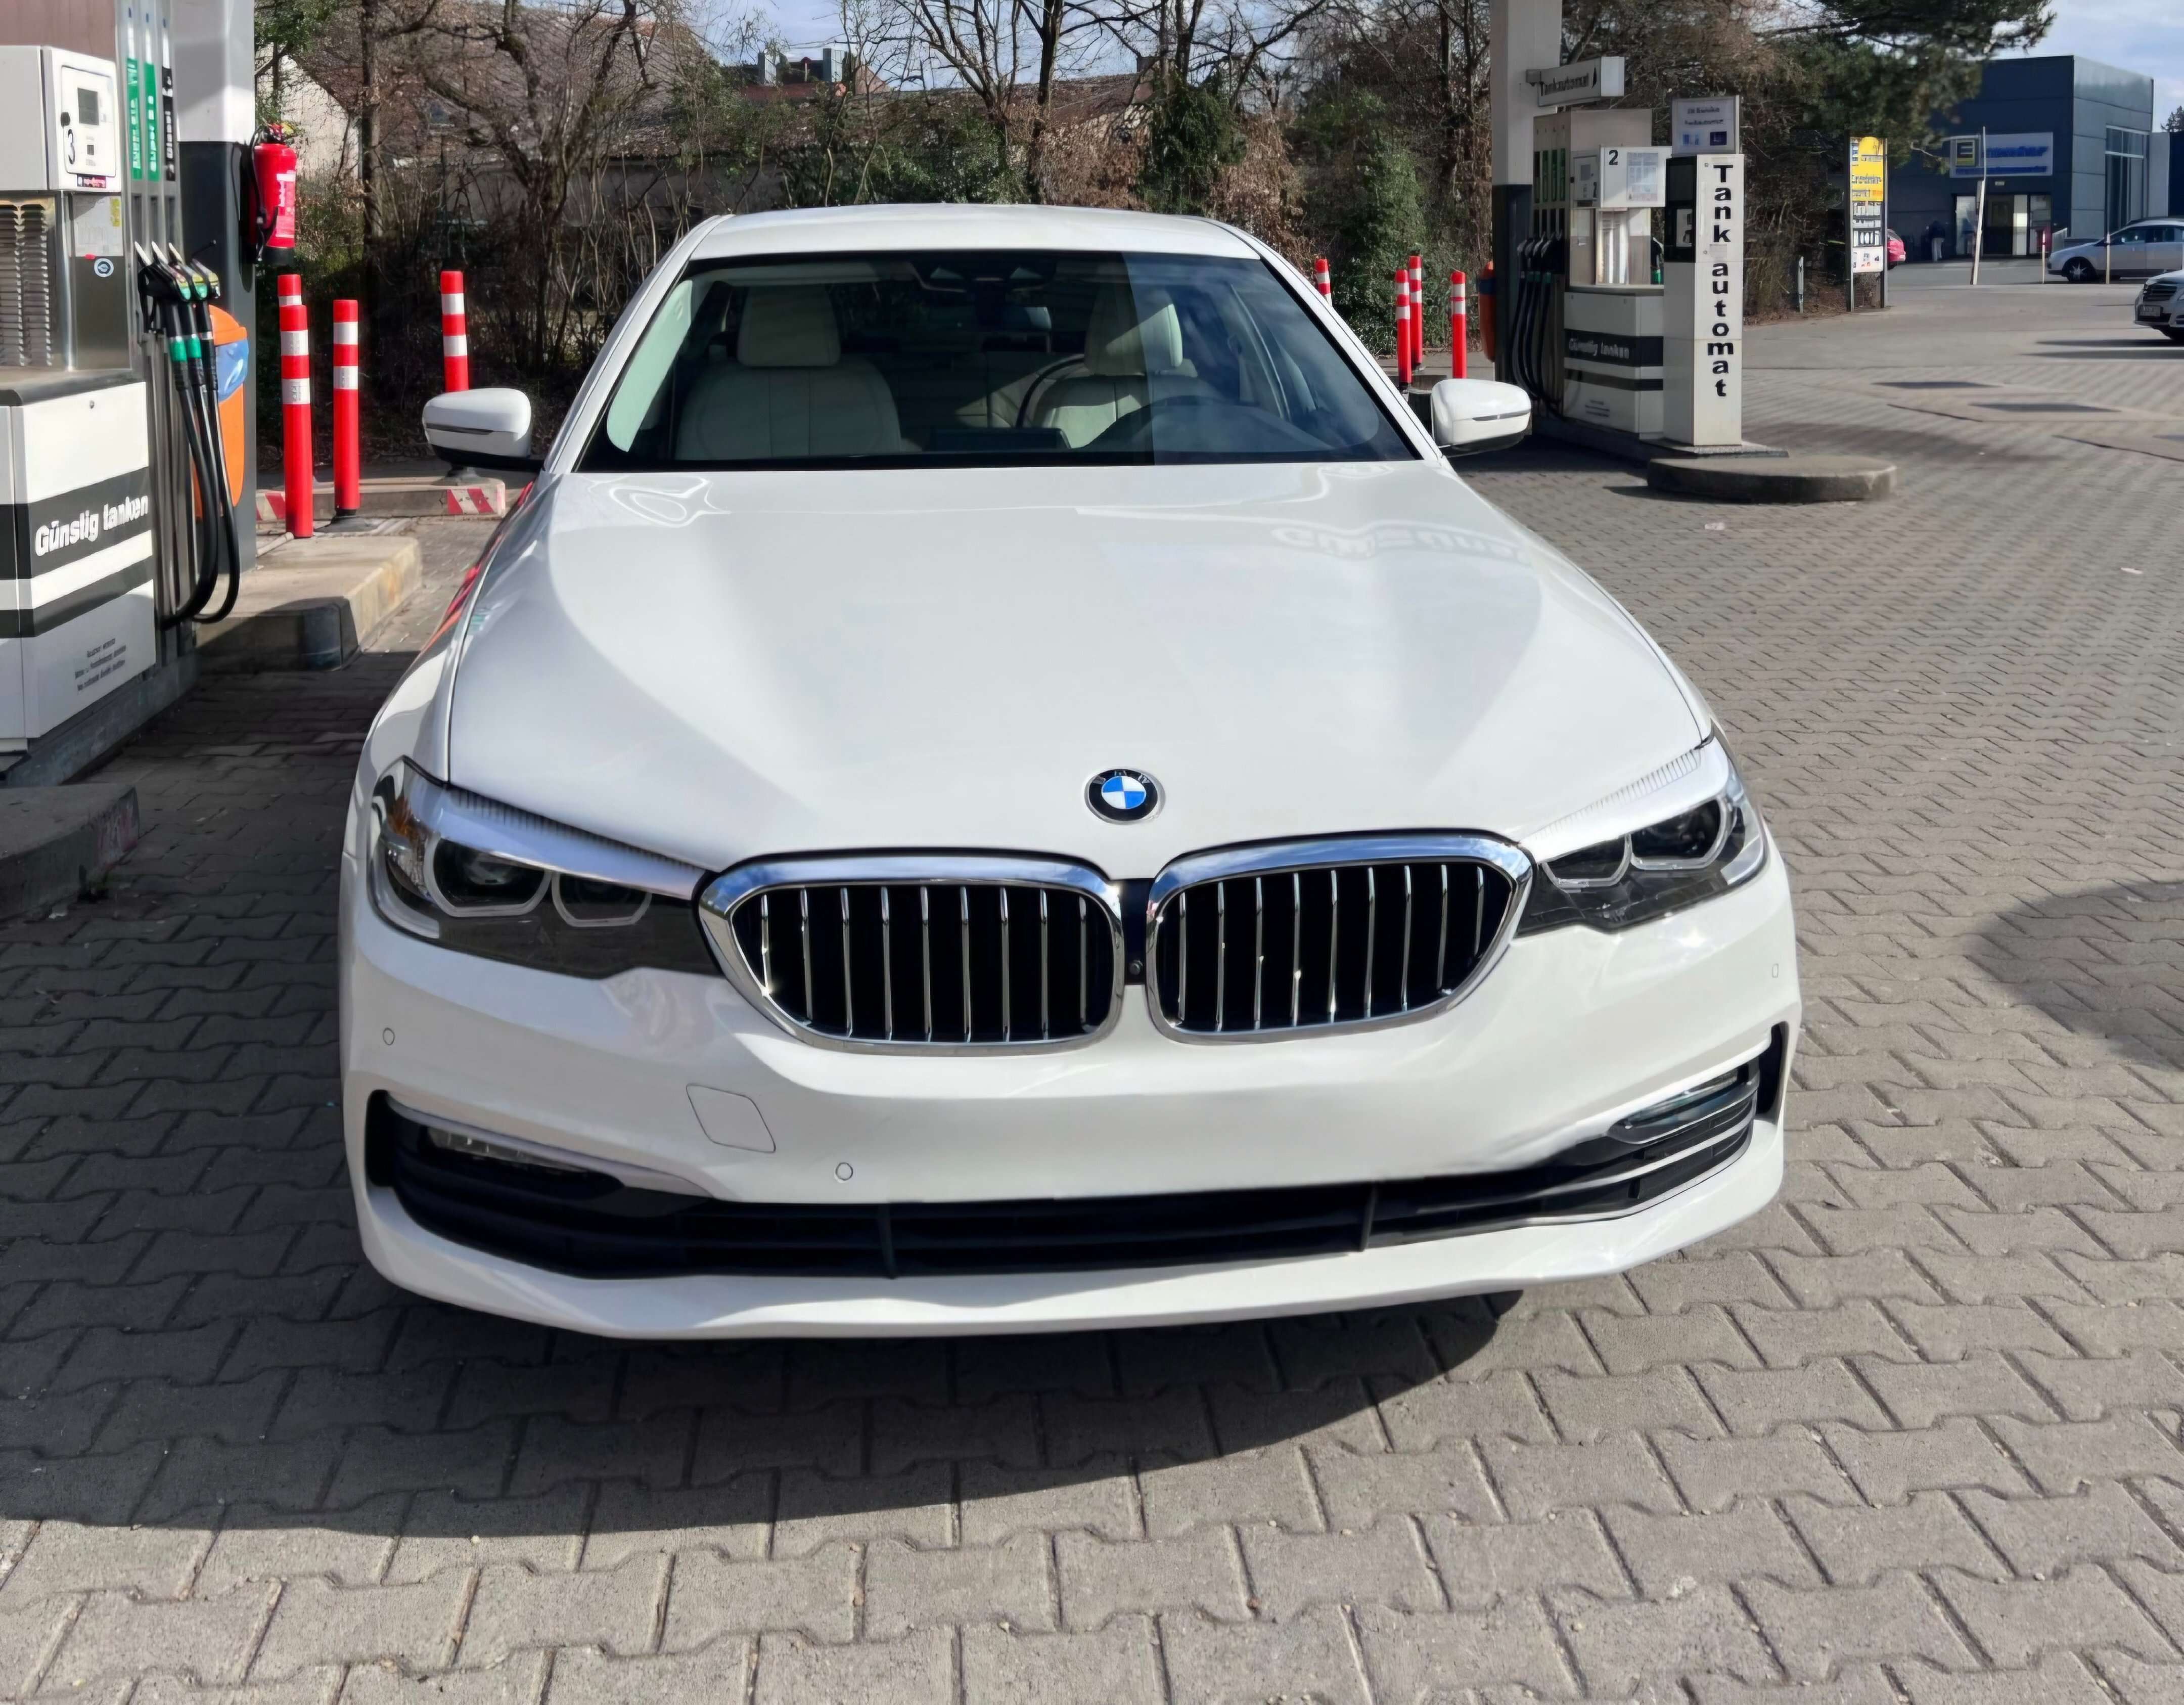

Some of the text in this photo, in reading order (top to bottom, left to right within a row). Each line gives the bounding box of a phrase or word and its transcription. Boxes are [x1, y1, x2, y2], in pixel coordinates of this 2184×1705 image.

[67, 128, 75, 165] 3
[1609, 149, 1618, 165] 2
[1707, 164, 1734, 397] Tank automat
[35, 510, 99, 557] Günstig
